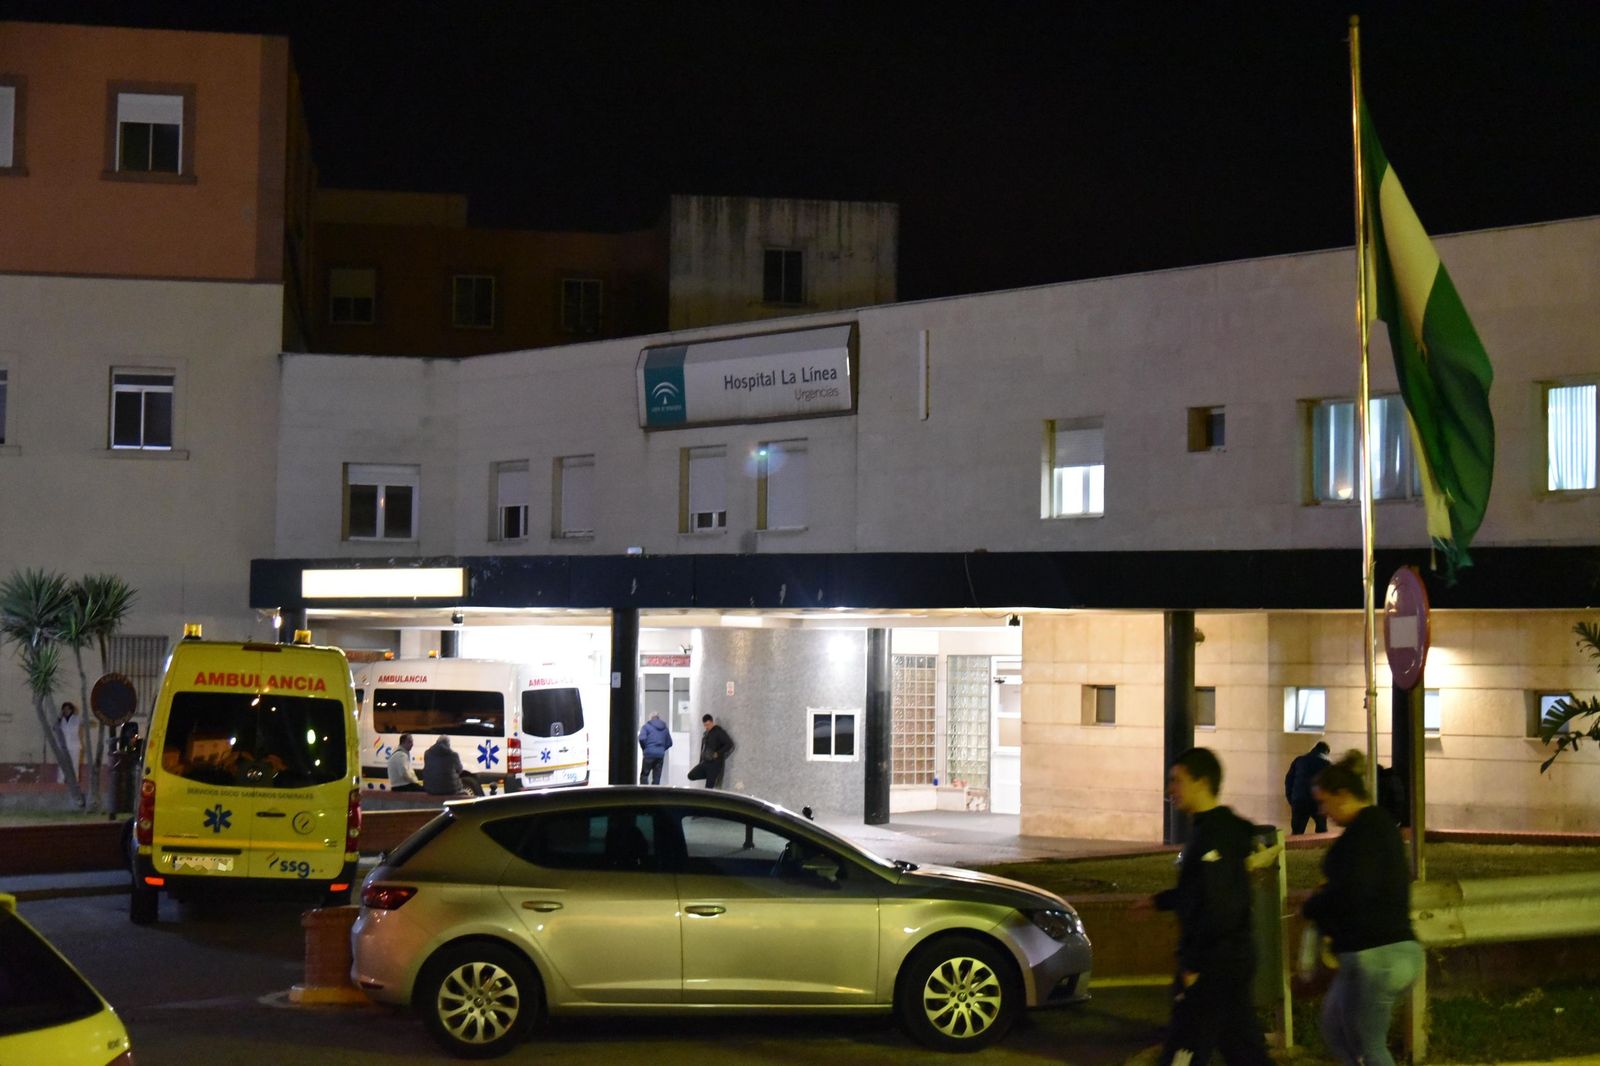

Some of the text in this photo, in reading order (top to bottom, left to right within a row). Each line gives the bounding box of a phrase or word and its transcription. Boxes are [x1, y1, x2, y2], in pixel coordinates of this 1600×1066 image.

[724, 366, 838, 392] Hospital La Línea
[794, 386, 840, 402] Urgencias
[194, 671, 327, 692] AMBULANCIA
[378, 674, 428, 683] AMBULANCIA
[528, 677, 574, 687] AMBUL
